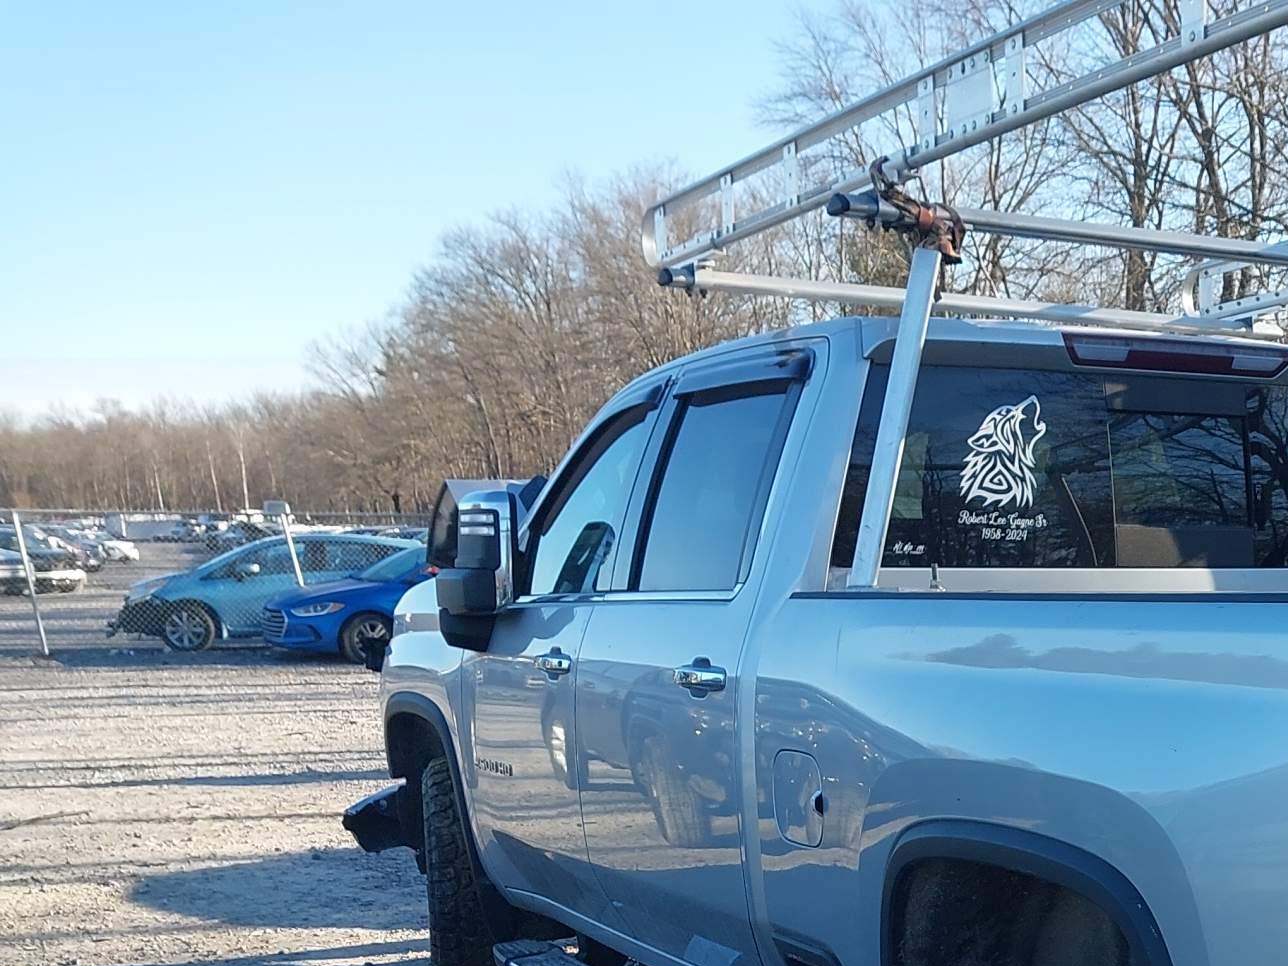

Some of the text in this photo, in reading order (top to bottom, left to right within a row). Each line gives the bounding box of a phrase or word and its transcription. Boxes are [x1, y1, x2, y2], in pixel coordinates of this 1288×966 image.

[957, 509, 987, 525] Robert
[988, 511, 1007, 526] Lee
[981, 527, 1028, 541] 1958-2024
